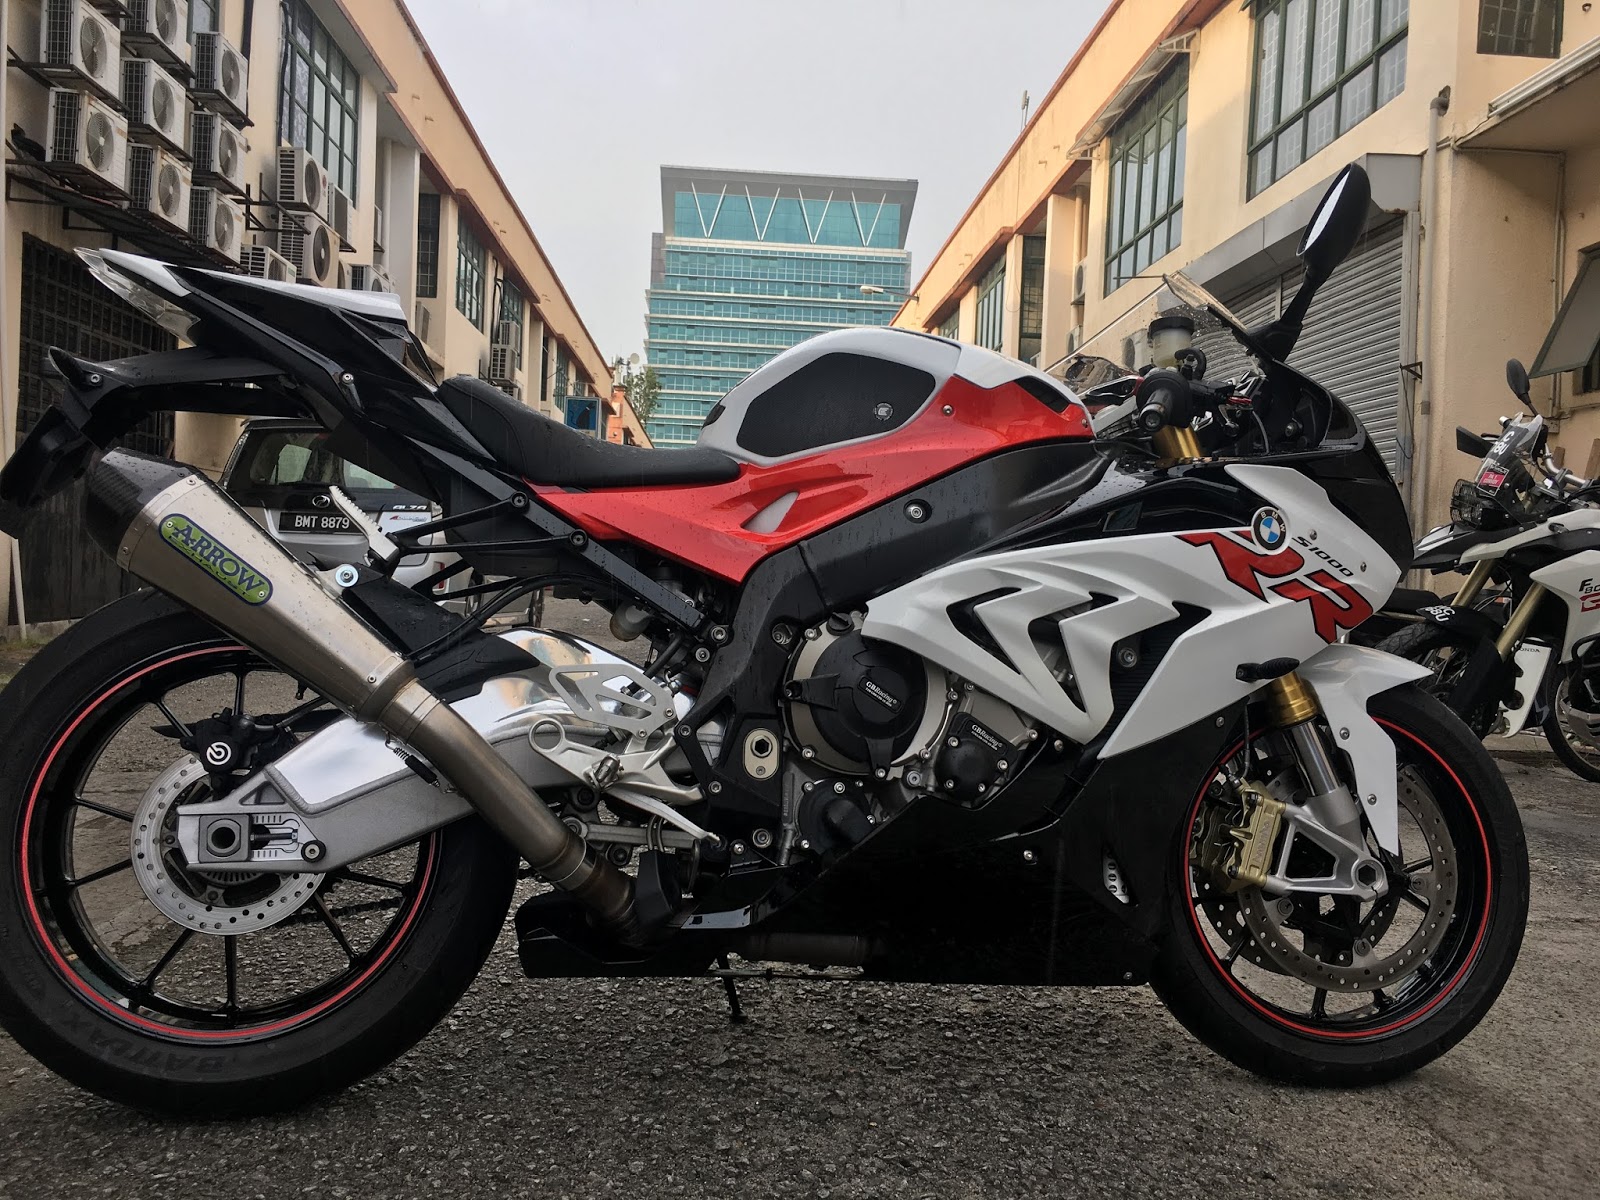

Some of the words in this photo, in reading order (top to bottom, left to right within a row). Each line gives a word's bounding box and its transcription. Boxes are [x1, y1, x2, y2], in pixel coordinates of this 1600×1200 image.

[295, 515, 318, 528] BMT
[321, 516, 350, 529] 8879
[1260, 511, 1287, 533] BMW
[172, 525, 266, 592] ARROW
[1292, 536, 1354, 577] S1000
